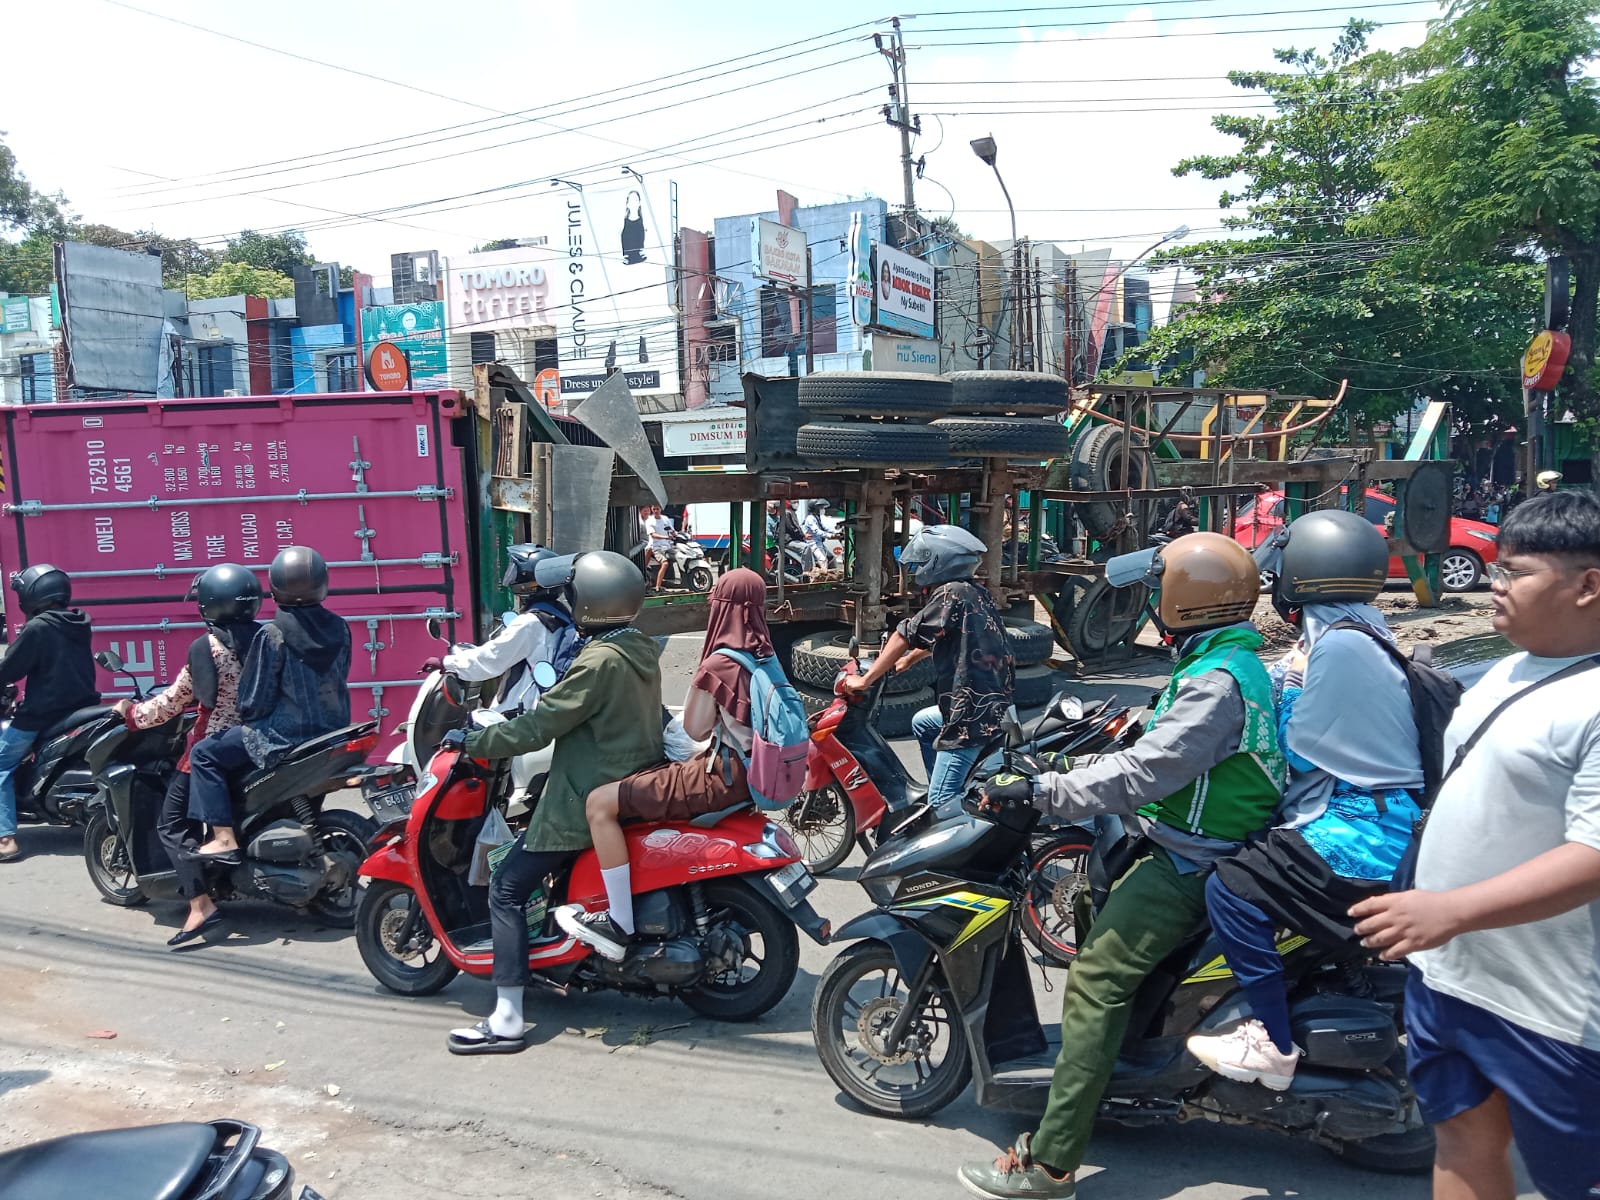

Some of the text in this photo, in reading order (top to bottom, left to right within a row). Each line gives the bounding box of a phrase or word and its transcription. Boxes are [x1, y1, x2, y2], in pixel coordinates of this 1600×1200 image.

[459, 265, 545, 291] TOMORO
[567, 201, 587, 359] JULES & CLAUDE
[897, 351, 936, 364] nu Siena
[564, 379, 589, 389] Dress
[690, 431, 733, 441] DIMSUM
[162, 444, 174, 455] kg
[86, 440, 108, 494] 752910
[113, 458, 132, 492] 45G1
[95, 516, 115, 553] ONEU
[170, 511, 192, 561] MAX GROSS
[241, 513, 259, 558] PAYLOAD
[276, 518, 293, 539] CAP.
[206, 534, 226, 559] TARE
[158, 640, 167, 677] EXPRESS
[905, 881, 940, 893] HONDA
